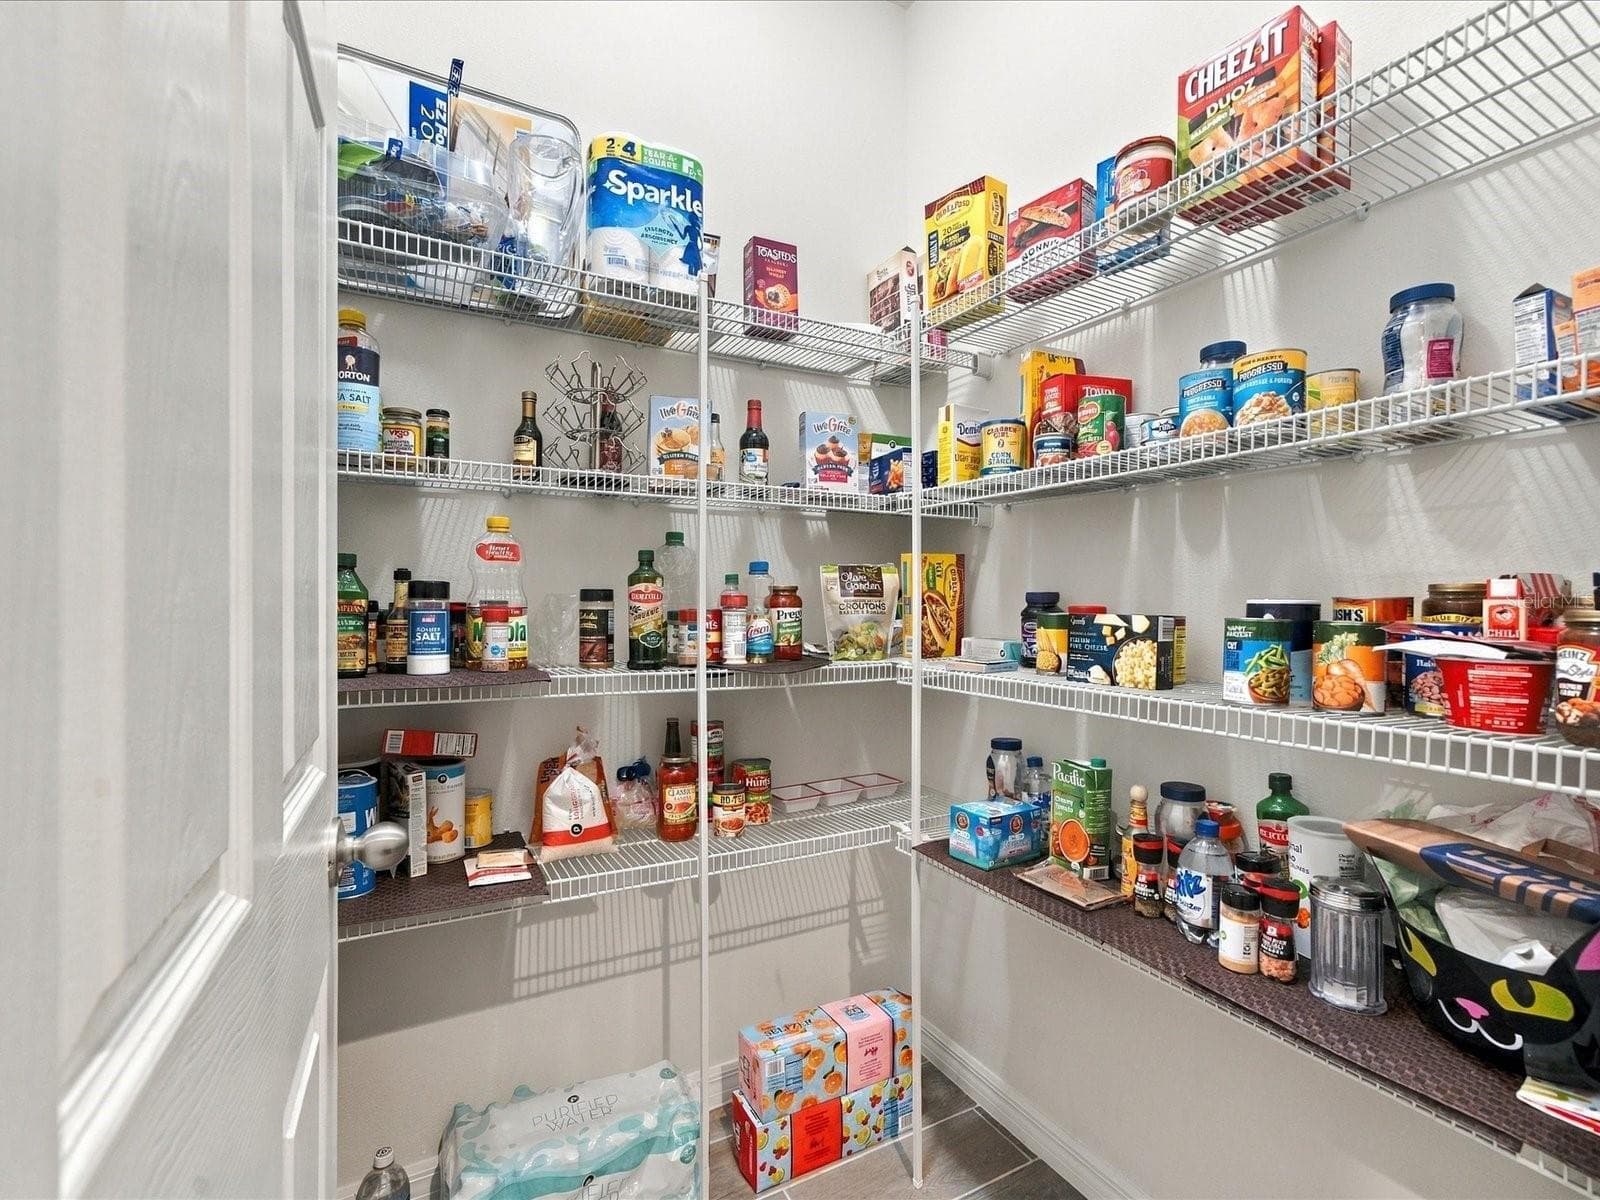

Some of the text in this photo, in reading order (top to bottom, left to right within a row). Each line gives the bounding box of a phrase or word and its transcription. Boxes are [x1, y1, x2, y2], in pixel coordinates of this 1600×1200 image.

[1206, 76, 1256, 119] DUOZ
[435, 97, 448, 124] EZ
[608, 169, 703, 217] Sparkle
[338, 370, 371, 382] ORTON
[1239, 362, 1284, 382] PROGRESSO
[1183, 379, 1222, 398] PROGRESSO
[349, 393, 372, 404] SALT
[988, 458, 1015, 466] STARCH
[841, 571, 867, 582] Olive
[845, 581, 882, 593] Garden
[839, 602, 887, 611] CROUTONS
[415, 632, 442, 640] SALT
[473, 622, 527, 642] Mola
[1487, 629, 1520, 638] CHILI
[1051, 762, 1086, 788] Pacific
[532, 1094, 618, 1127] PURIFIED
[546, 1106, 613, 1132] WATER
